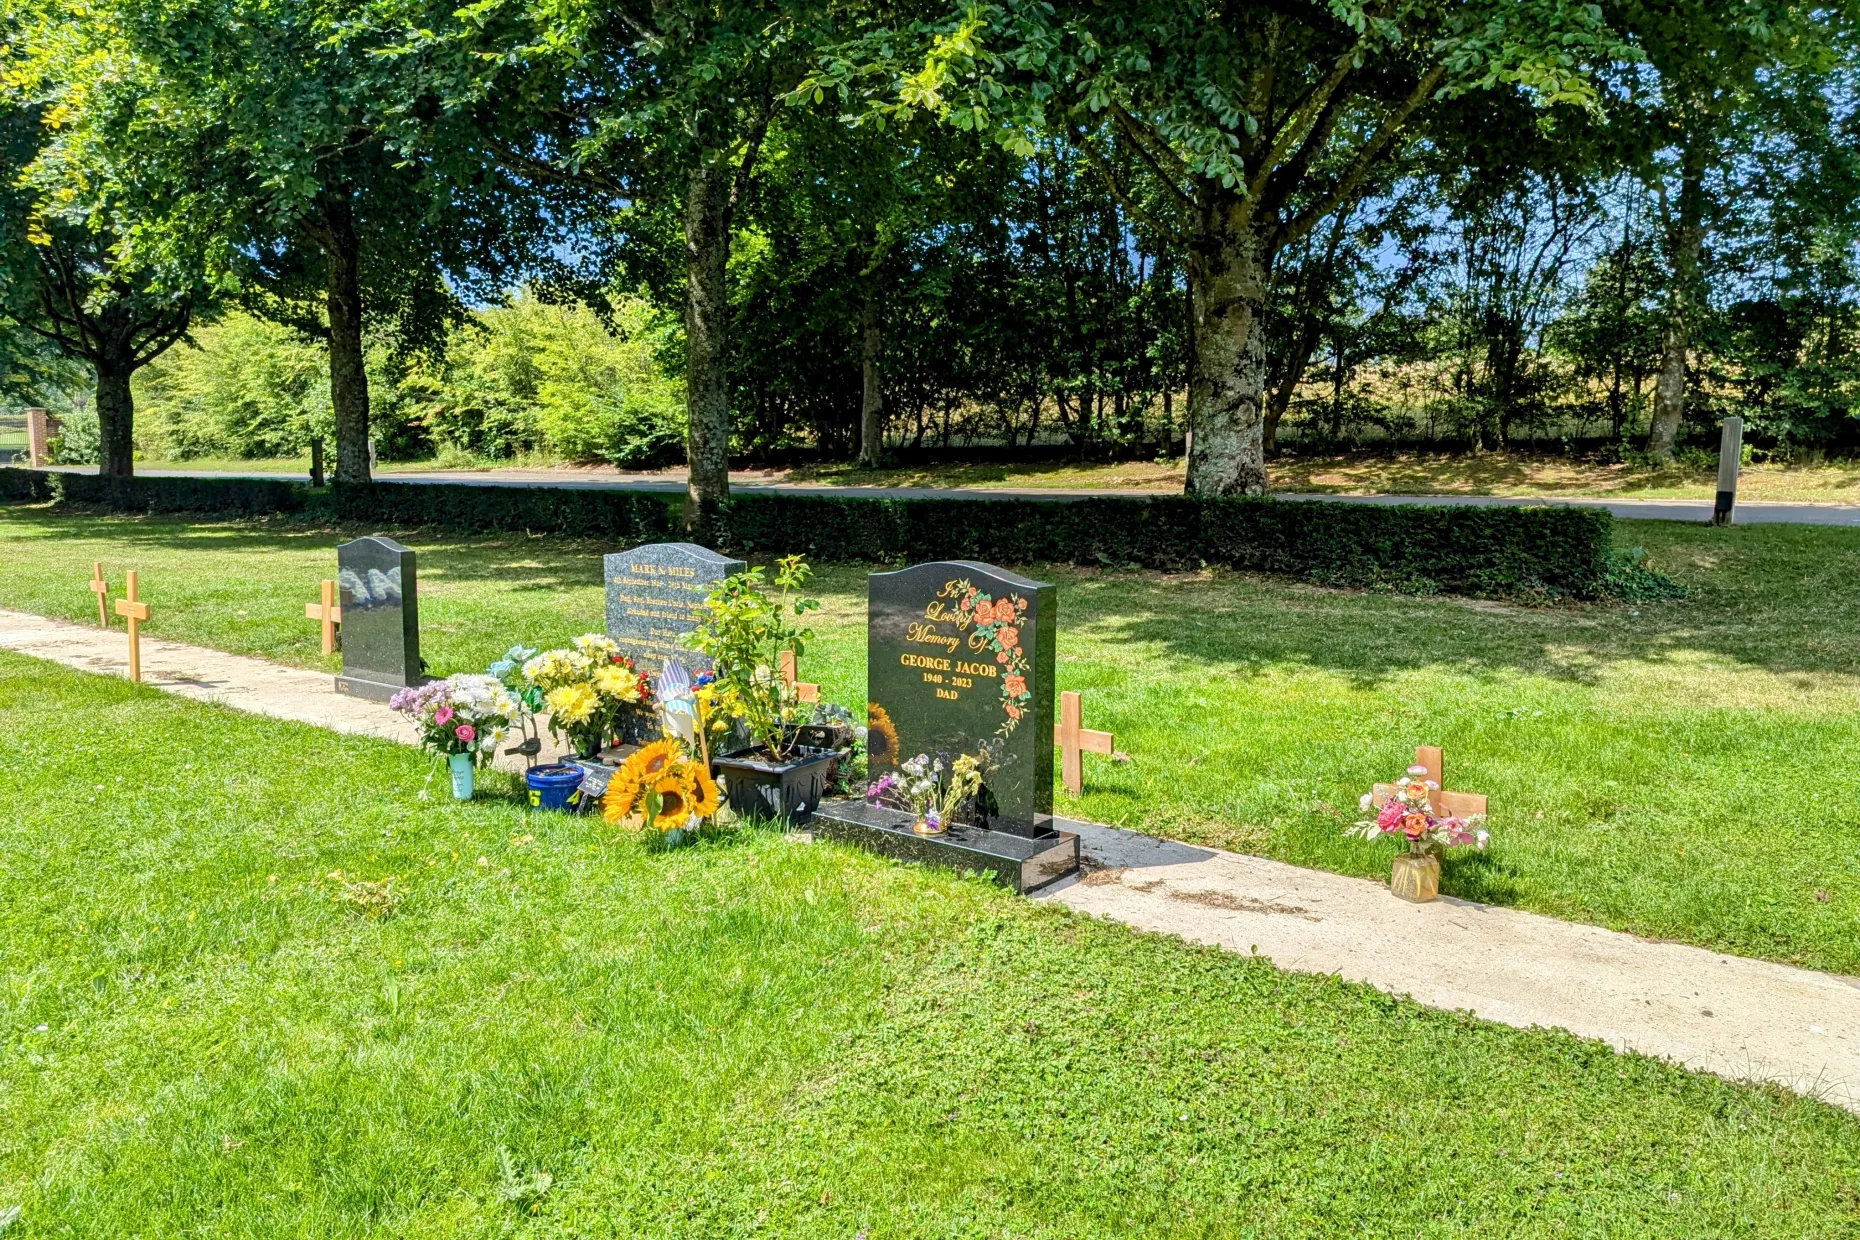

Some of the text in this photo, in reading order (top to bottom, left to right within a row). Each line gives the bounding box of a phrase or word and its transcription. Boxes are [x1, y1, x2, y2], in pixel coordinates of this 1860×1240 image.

[630, 563, 656, 574] MARK
[668, 566, 695, 578] MILES
[936, 580, 960, 598] In
[925, 601, 973, 630] Loving
[906, 622, 988, 654] Memory Of
[900, 654, 997, 677] GEORGE JACOB
[923, 673, 942, 684] 1940
[952, 677, 972, 688] 2023
[936, 688, 958, 700] DAD
